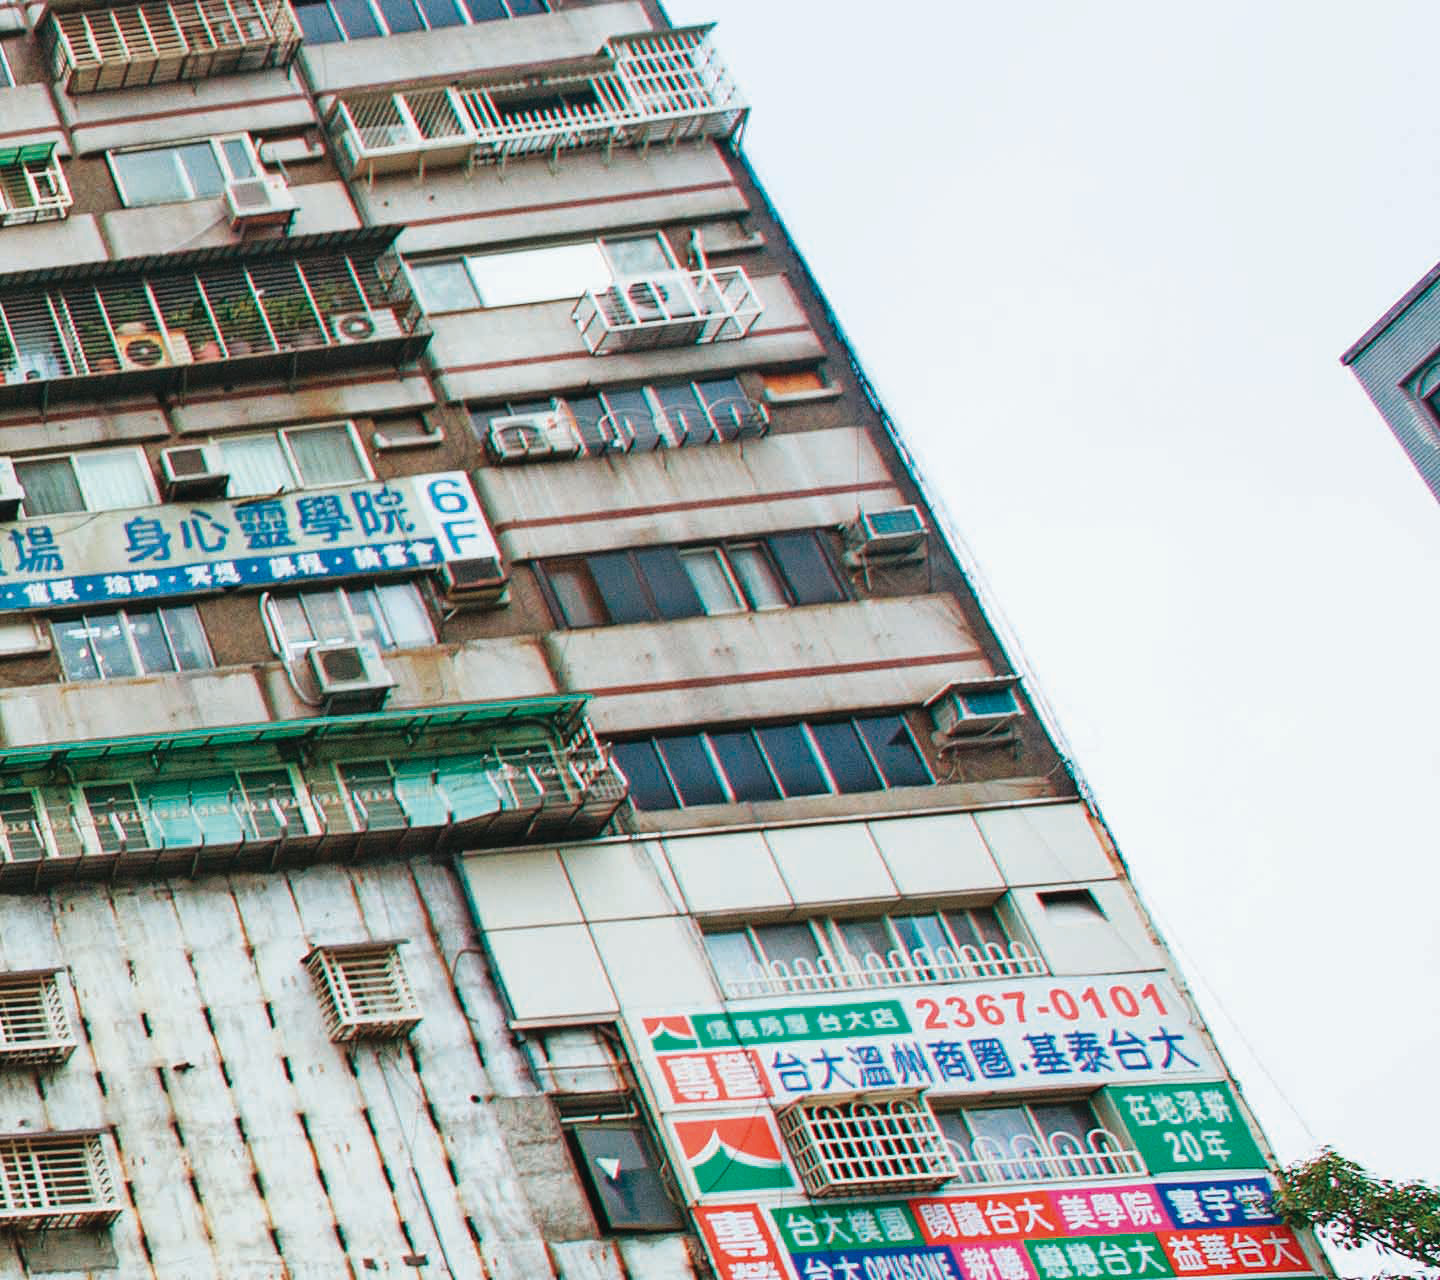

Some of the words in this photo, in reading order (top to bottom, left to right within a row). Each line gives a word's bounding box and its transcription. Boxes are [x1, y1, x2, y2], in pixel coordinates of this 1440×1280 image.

[124, 485, 417, 564] 身心靈學院
[427, 477, 481, 555] 6F
[915, 983, 1169, 1030] 2367-0101
[1163, 1129, 1232, 1165] 20年
[918, 1196, 1056, 1239] 閱讀台大
[1058, 1189, 1163, 1231] 美學院
[1168, 1231, 1303, 1271] 益華台大
